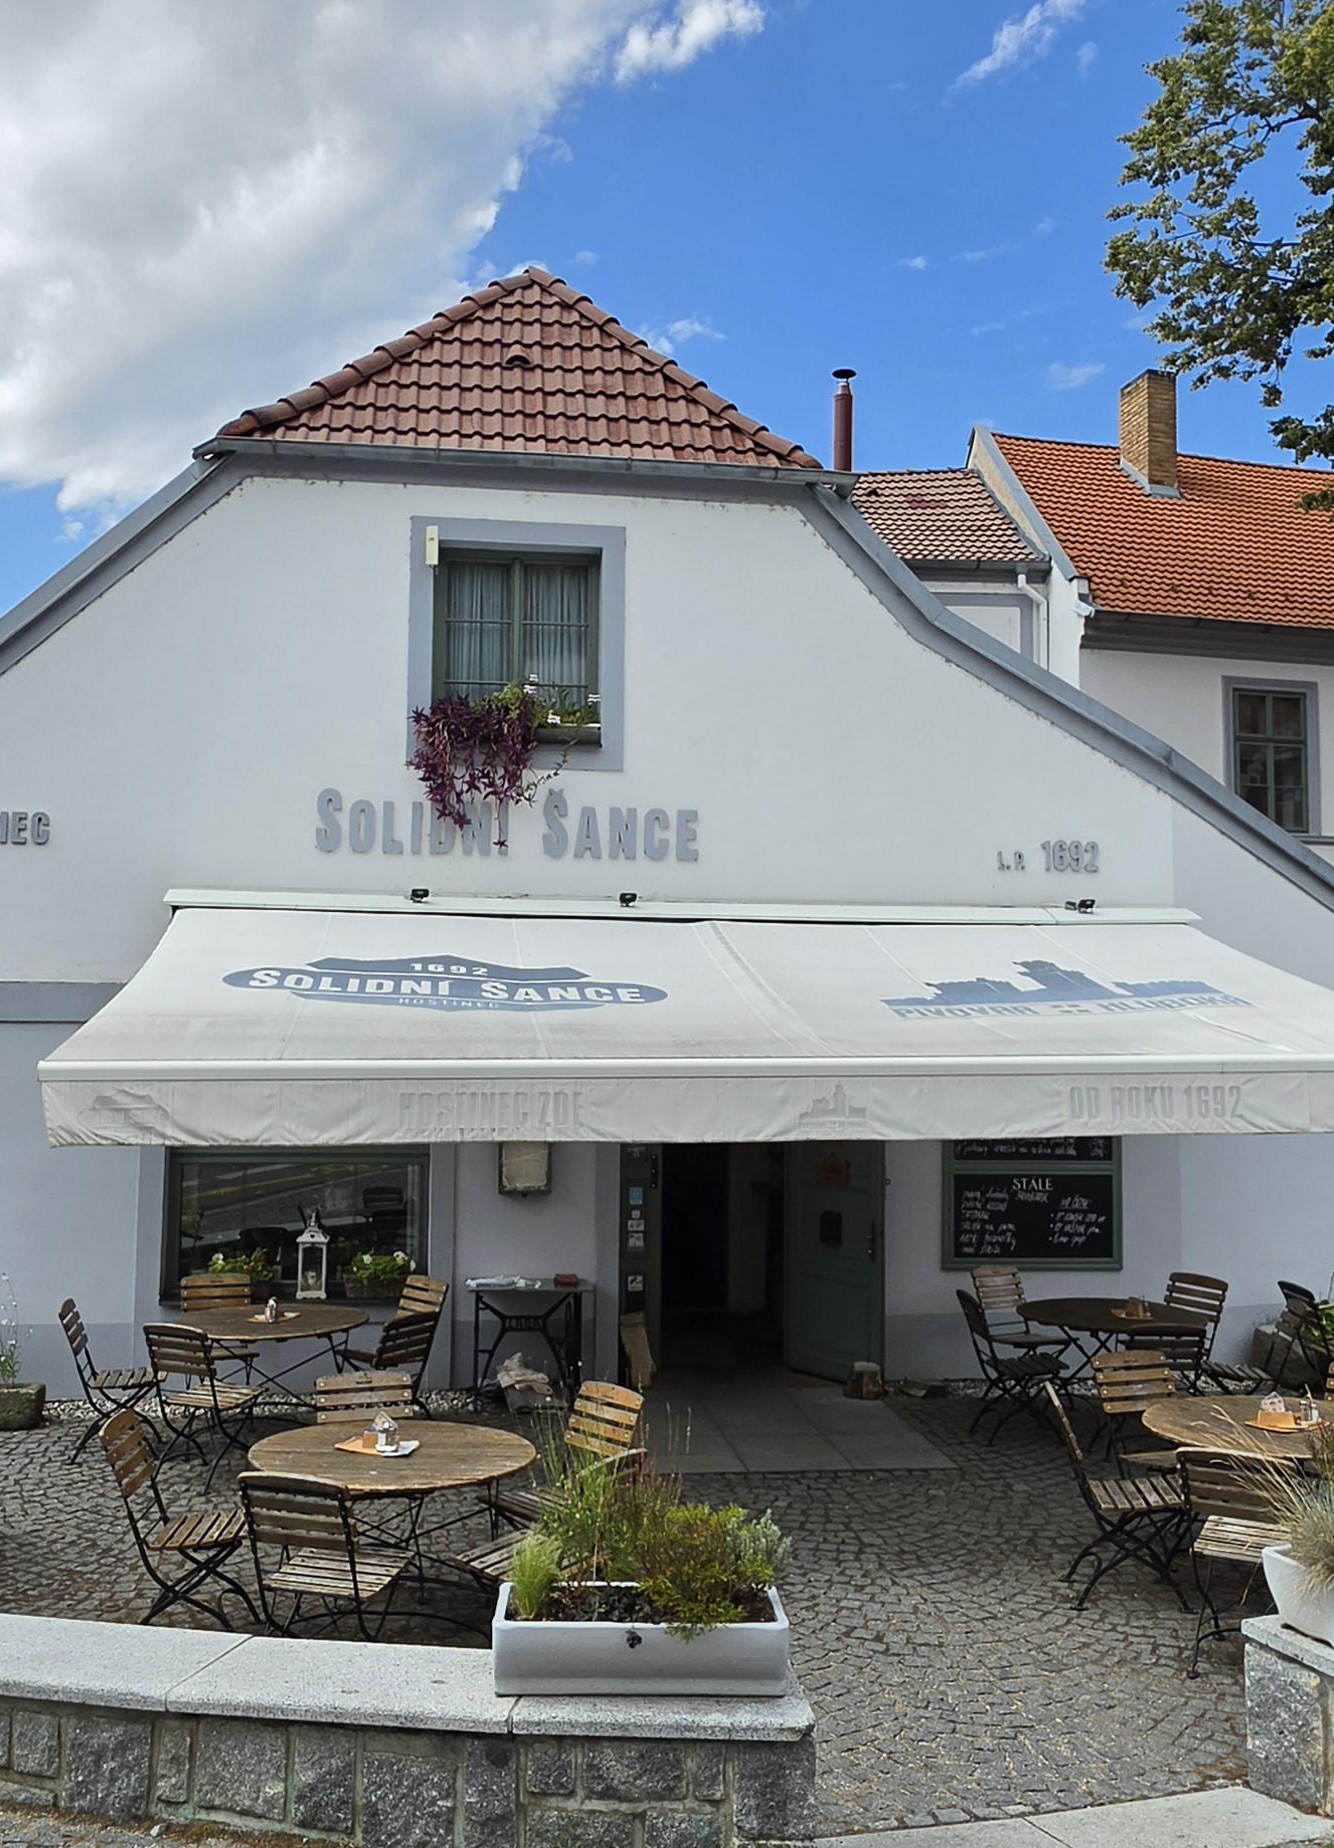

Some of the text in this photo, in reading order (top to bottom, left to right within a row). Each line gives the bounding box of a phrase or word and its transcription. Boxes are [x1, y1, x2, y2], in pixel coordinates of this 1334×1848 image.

[542, 788, 699, 863] ŠANCE
[1040, 839, 1099, 873] 1692
[249, 969, 646, 1003] SOLIDNÍ ŠANCE
[411, 963, 488, 976] 1692
[398, 997, 500, 1009] HOSTINEC
[892, 1005, 1039, 1018] PIVOVAR
[399, 1091, 584, 1128] HOSTINEC ZDE
[1070, 1085, 1243, 1119] OD ROKU 1692
[1012, 1176, 1054, 1191] STÁLE
